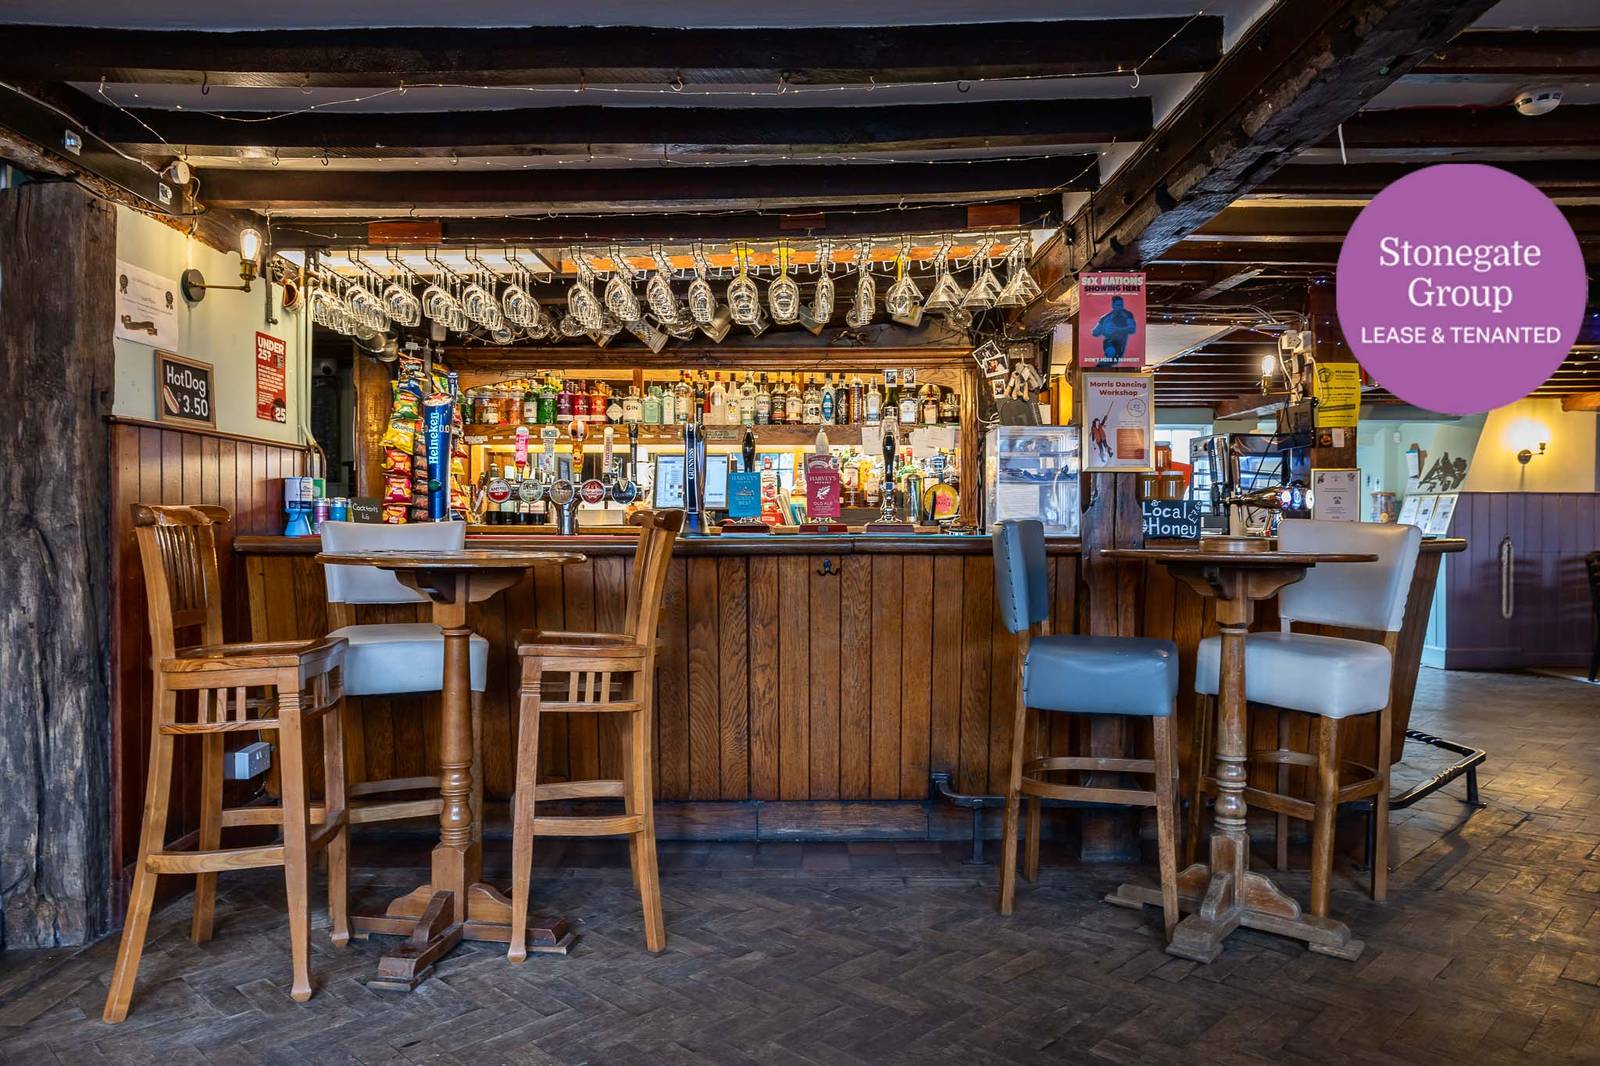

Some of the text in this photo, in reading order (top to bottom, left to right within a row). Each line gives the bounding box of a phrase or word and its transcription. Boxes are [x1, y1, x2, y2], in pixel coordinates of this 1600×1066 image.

[1081, 276, 1144, 286] SIX NATIONS
[257, 336, 284, 354] UNDER
[258, 348, 271, 362] 25?
[166, 365, 206, 398] HotDog
[1116, 381, 1147, 389] Dancing
[275, 407, 286, 422] 25
[428, 412, 440, 464] Heineken
[688, 448, 696, 480] GUINNESS
[1142, 501, 1187, 519] Local
[1149, 517, 1197, 539] Honey
